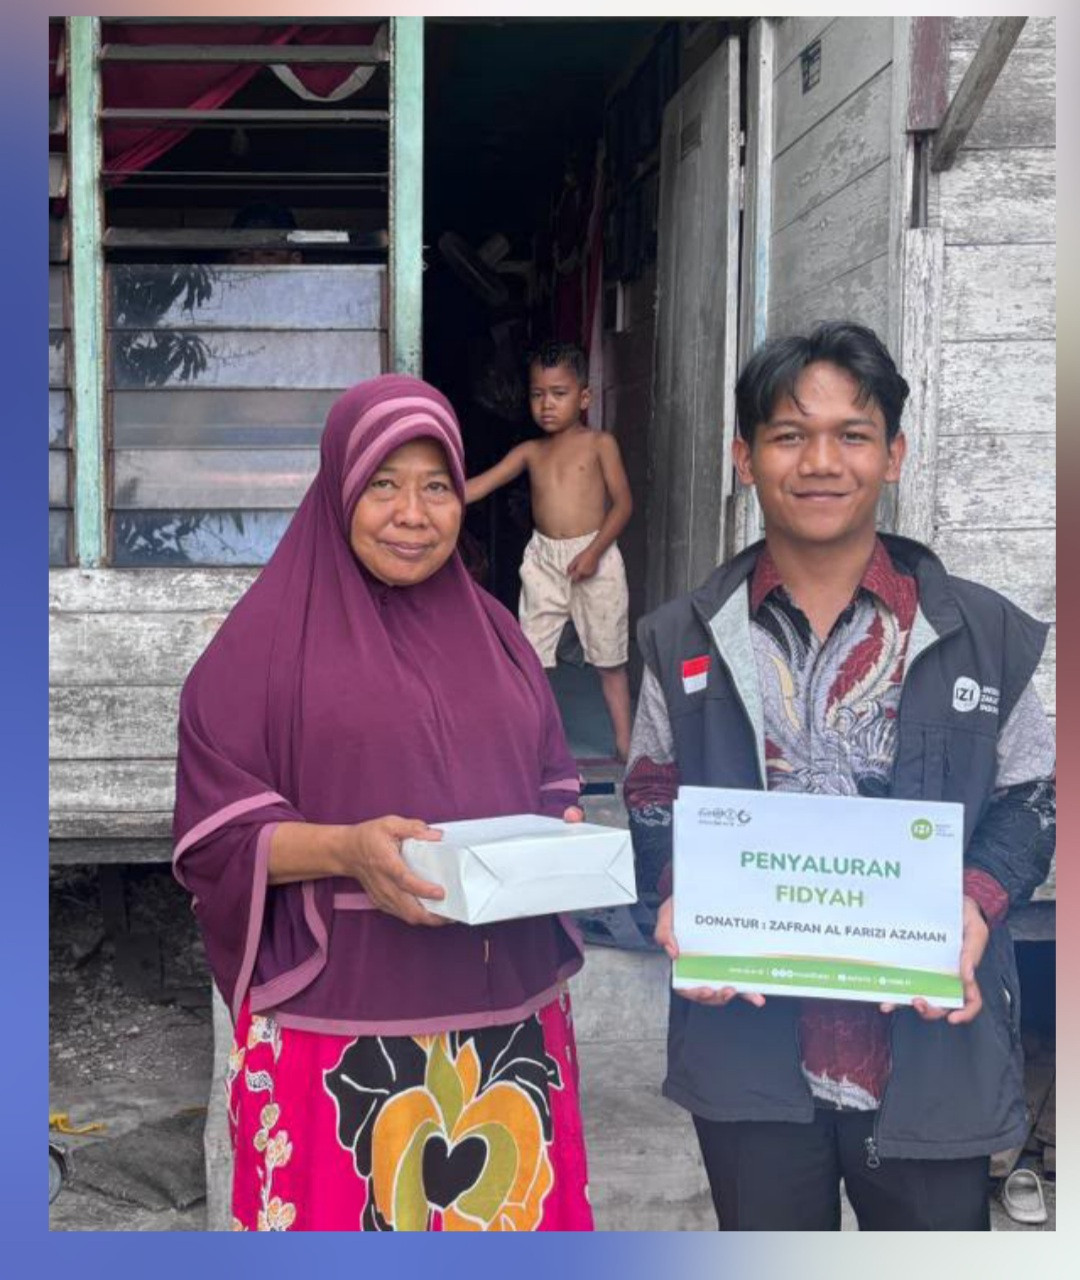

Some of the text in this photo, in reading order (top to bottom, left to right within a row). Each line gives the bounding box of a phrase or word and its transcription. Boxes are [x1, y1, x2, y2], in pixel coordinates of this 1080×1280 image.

[956, 686, 974, 702] IZI
[740, 851, 901, 878] PENYALURAN
[775, 885, 865, 908] FIDYAH
[694, 915, 760, 930] DONATUR
[769, 920, 822, 934] ZAFRAN
[825, 924, 841, 936] AL
[845, 926, 887, 938] FARIZI
[889, 929, 947, 943] AZAMAN
